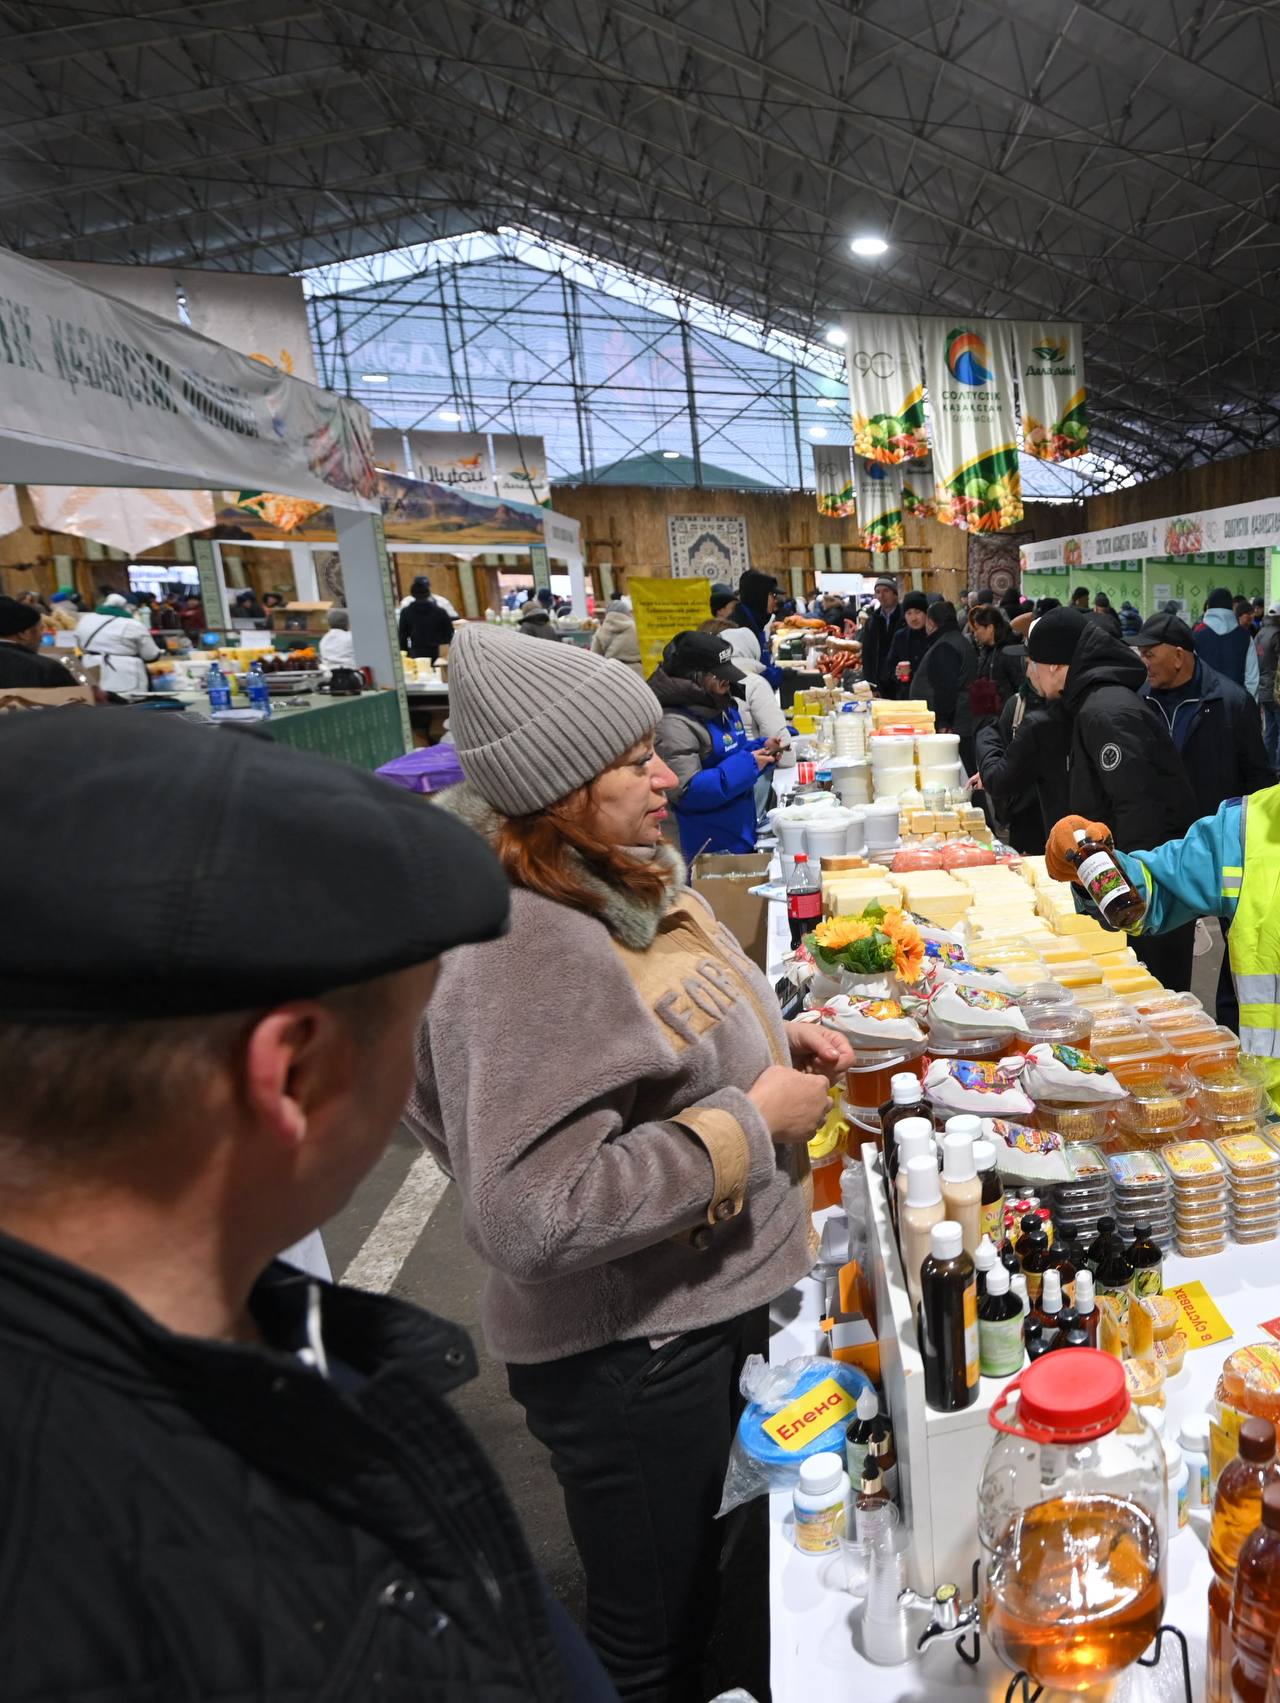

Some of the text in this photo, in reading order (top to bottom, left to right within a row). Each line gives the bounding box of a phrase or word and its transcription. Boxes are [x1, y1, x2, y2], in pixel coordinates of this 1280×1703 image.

[1173, 1288, 1207, 1332] суставах
[1201, 1333, 1213, 1342] в
[776, 1393, 843, 1440] Елена
